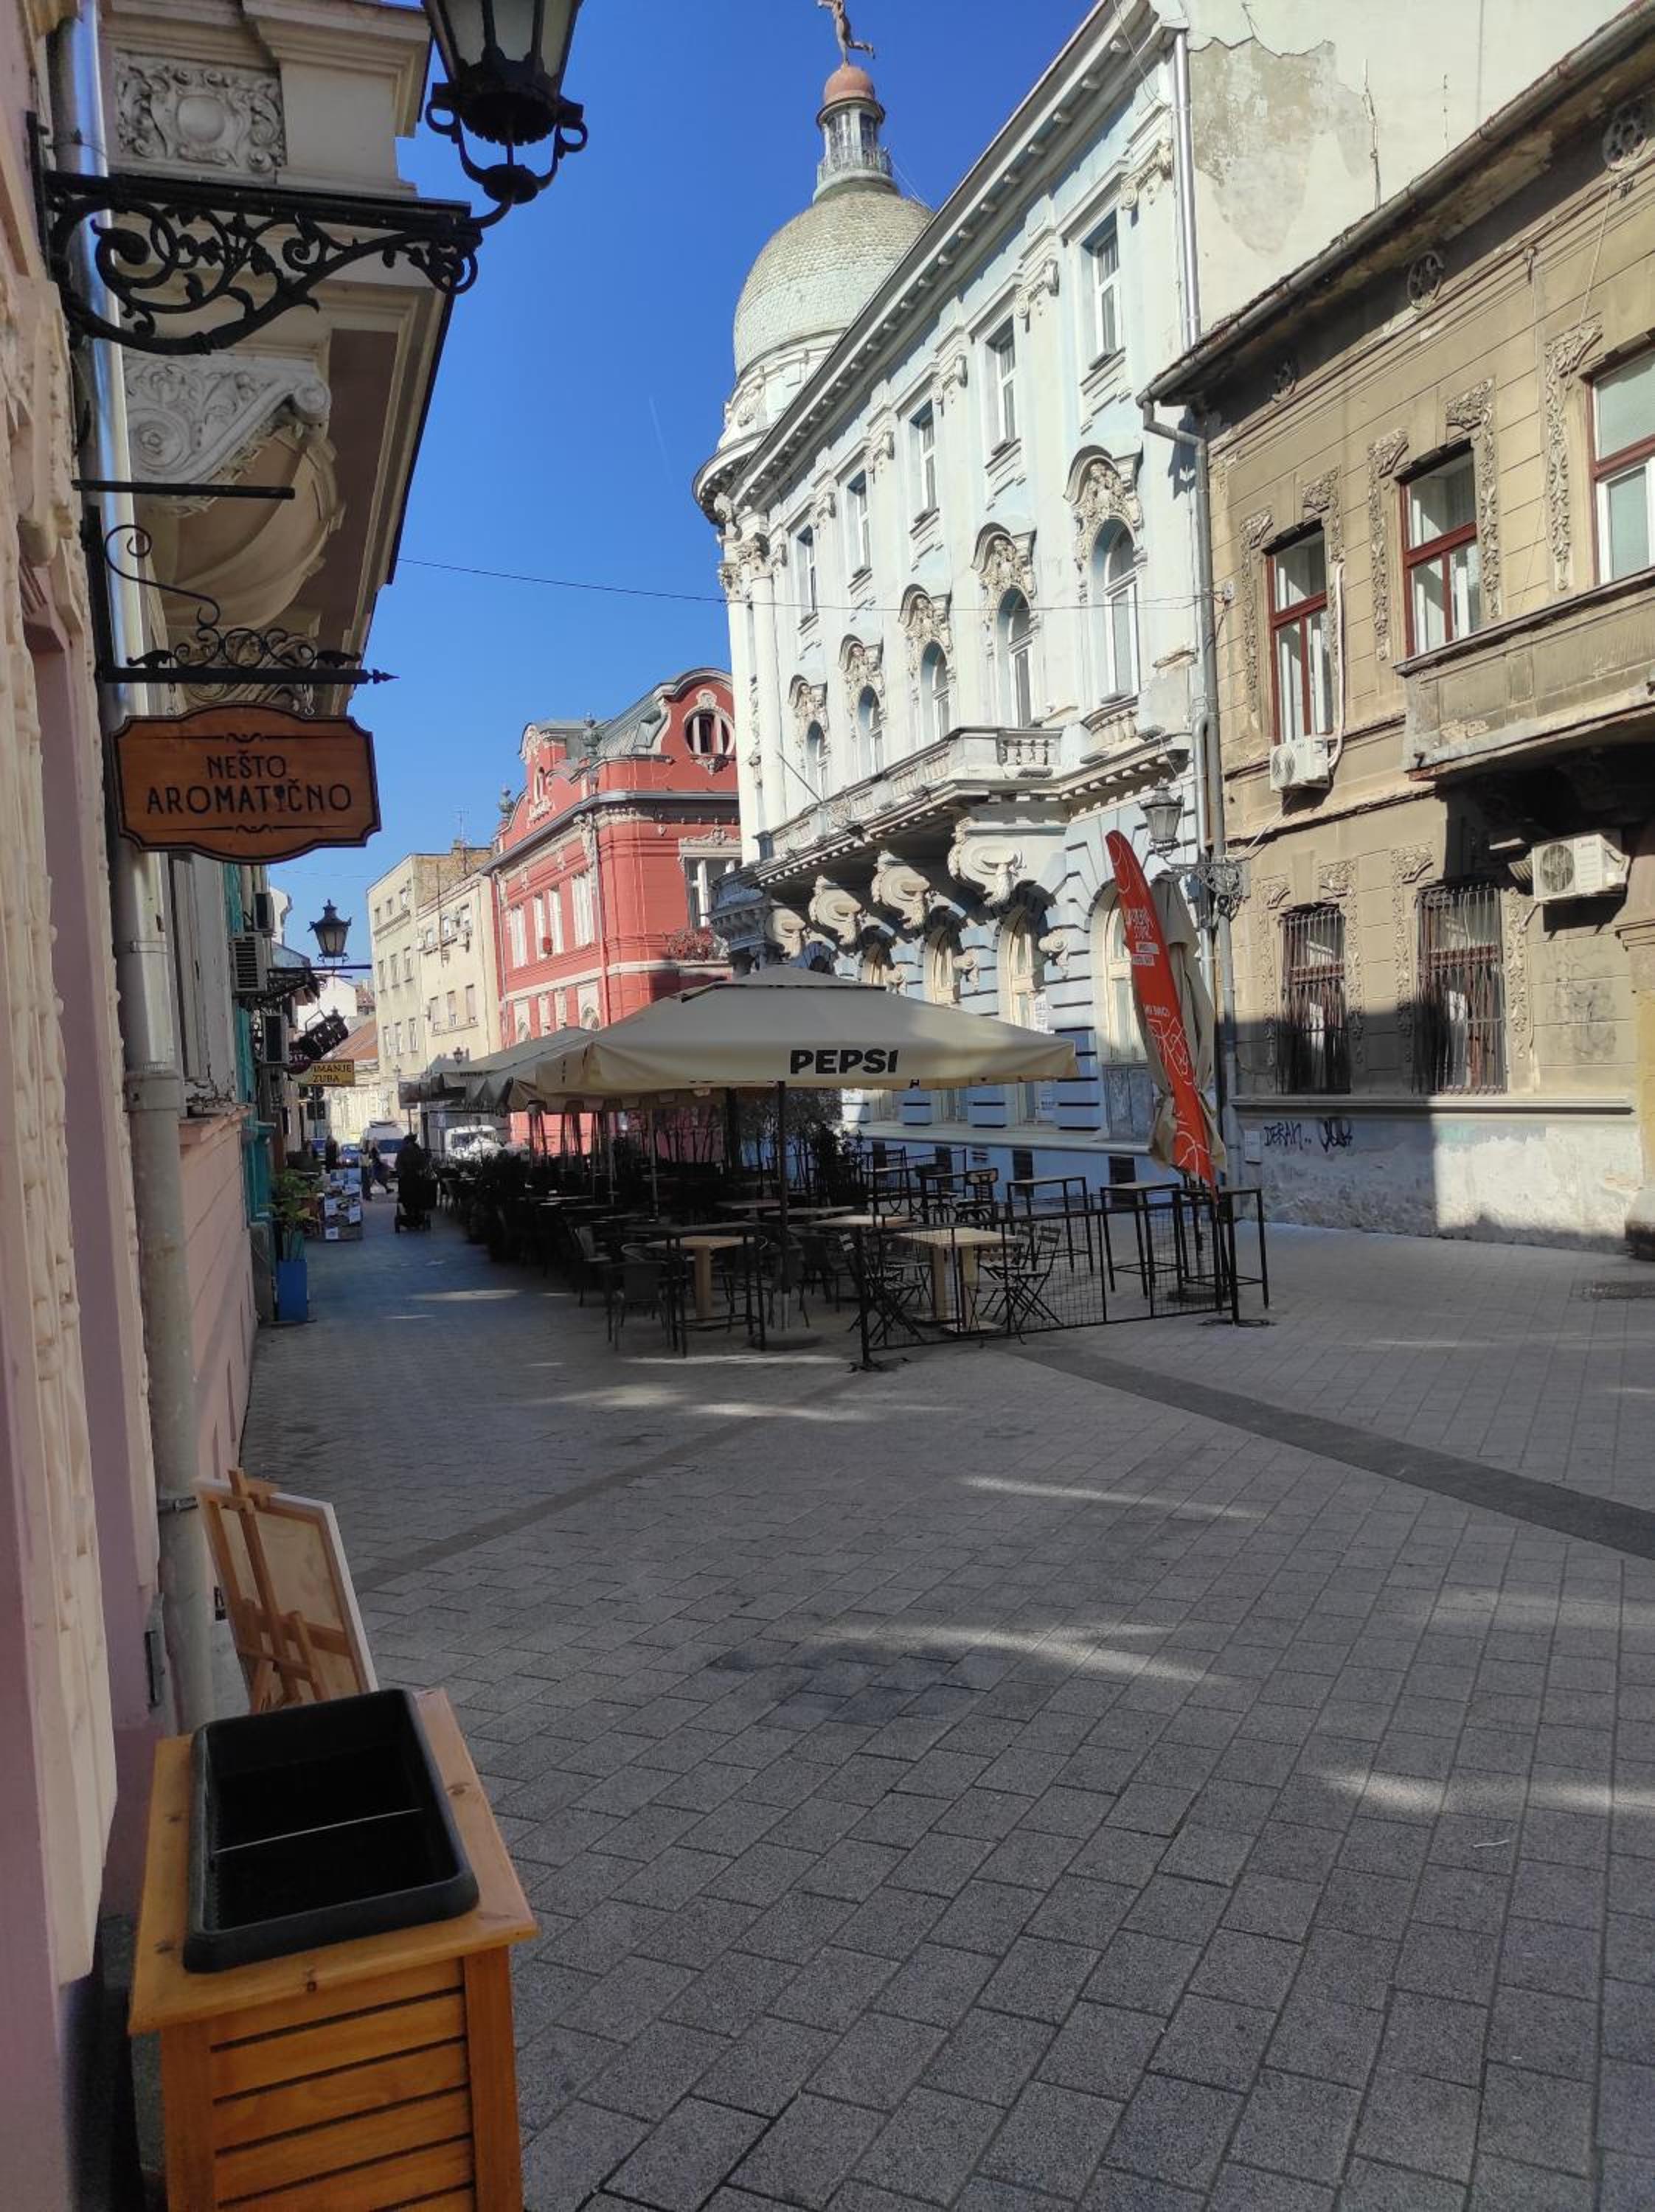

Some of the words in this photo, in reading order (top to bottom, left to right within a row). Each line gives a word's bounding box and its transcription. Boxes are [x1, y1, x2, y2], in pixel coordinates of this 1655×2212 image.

[205, 749, 288, 779] NEŠTO
[146, 779, 353, 815] AROMATIČNO
[310, 1064, 352, 1073] IMANJE
[789, 1048, 898, 1074] PEPSI
[312, 1074, 340, 1083] ZUBA
